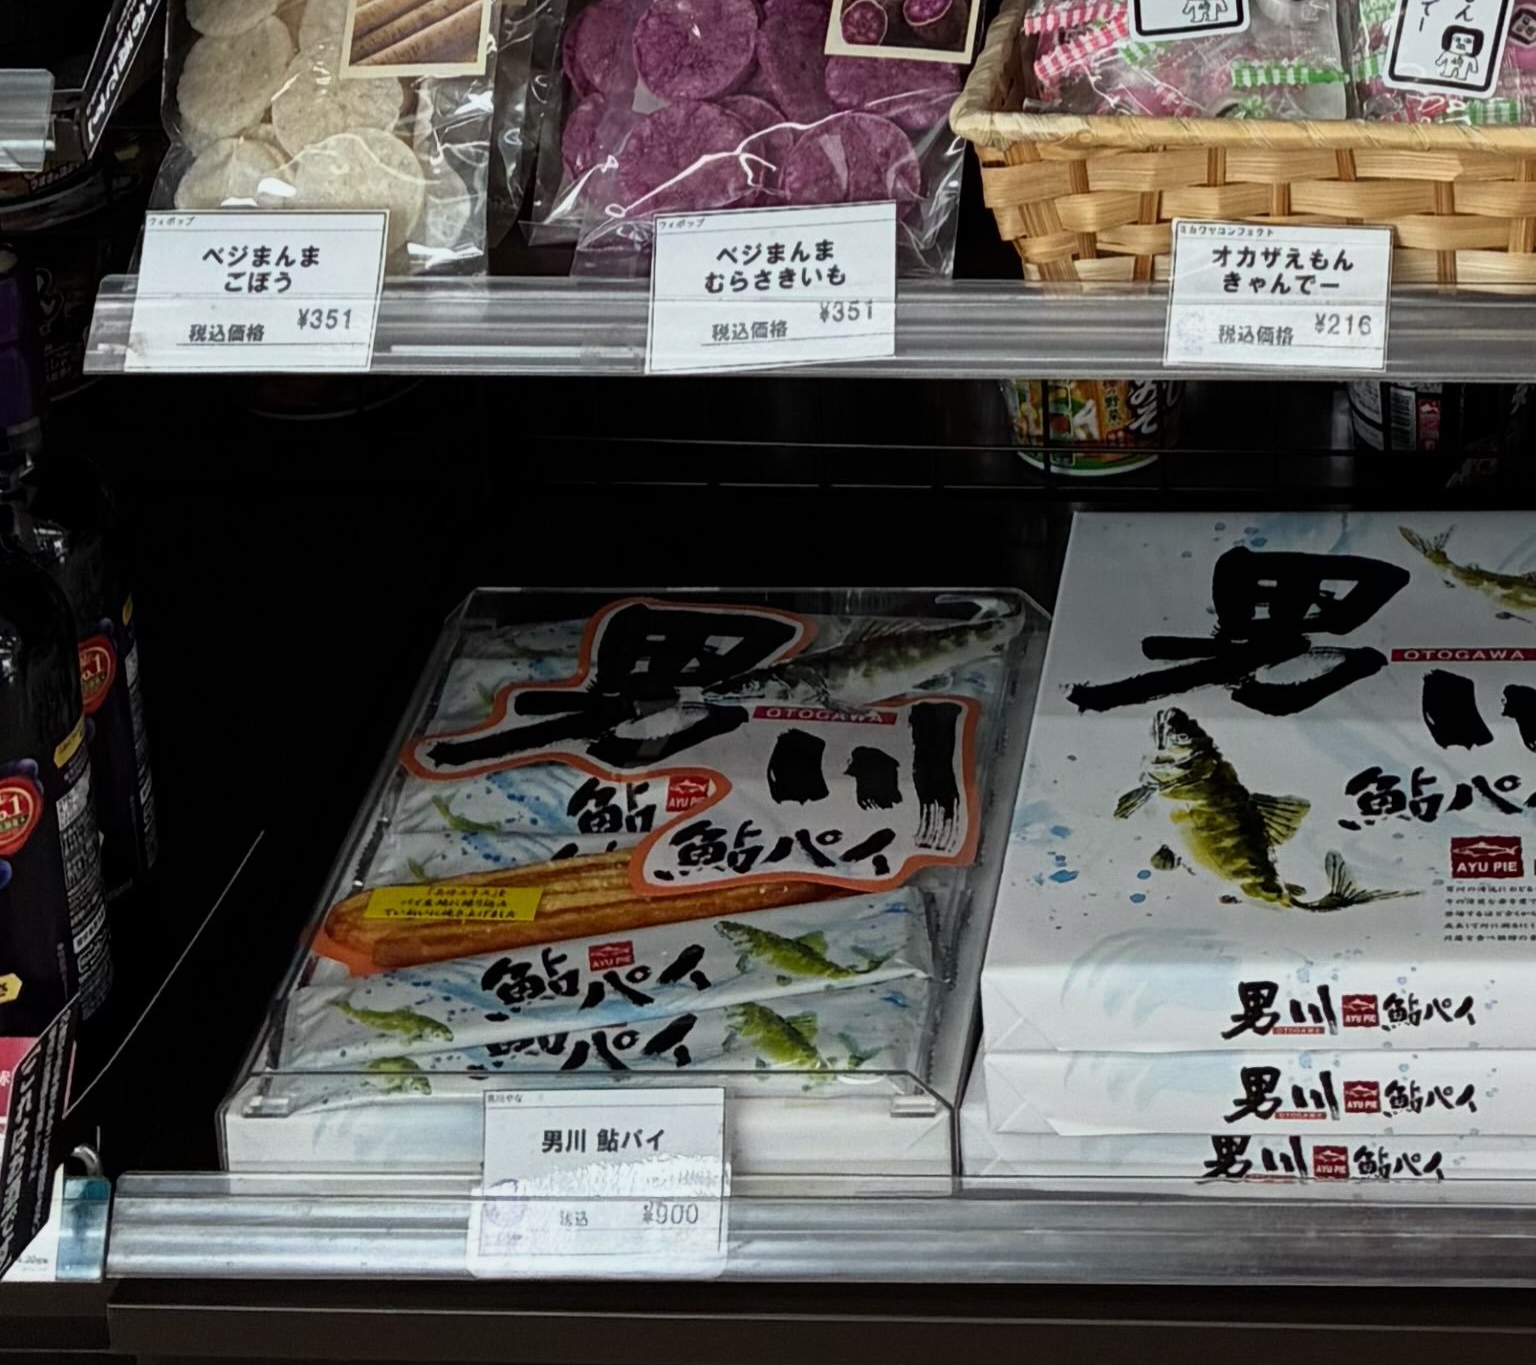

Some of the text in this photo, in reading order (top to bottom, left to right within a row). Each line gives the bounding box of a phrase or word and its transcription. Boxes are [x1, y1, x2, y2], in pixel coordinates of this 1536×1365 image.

[202, 244, 321, 268] ベジまんま
[716, 238, 835, 266] ベジまんま
[1211, 245, 1354, 272] オカザえもん
[223, 270, 293, 294] ごぼう
[704, 264, 847, 294] むらさきいも
[1223, 271, 1340, 296] きゃんでー
[188, 307, 353, 343] 税込価格 ¥351
[711, 300, 874, 342] 税込価格 ¥351
[1218, 312, 1373, 347] 税込価格 ¥216
[1403, 648, 1527, 662] OTOGAWA
[425, 602, 962, 853] 男川
[766, 706, 886, 724] OTOGAWA
[652, 817, 898, 882] 鮎パイ
[1456, 860, 1519, 874] AYU PIE
[480, 943, 708, 1025] 鮎パイ
[1221, 980, 1477, 1041] 男川 鮎パイ
[1223, 1066, 1479, 1124] 男川 鮎パイ
[541, 1128, 588, 1155] 男川
[643, 1201, 700, 1226] ¥900
